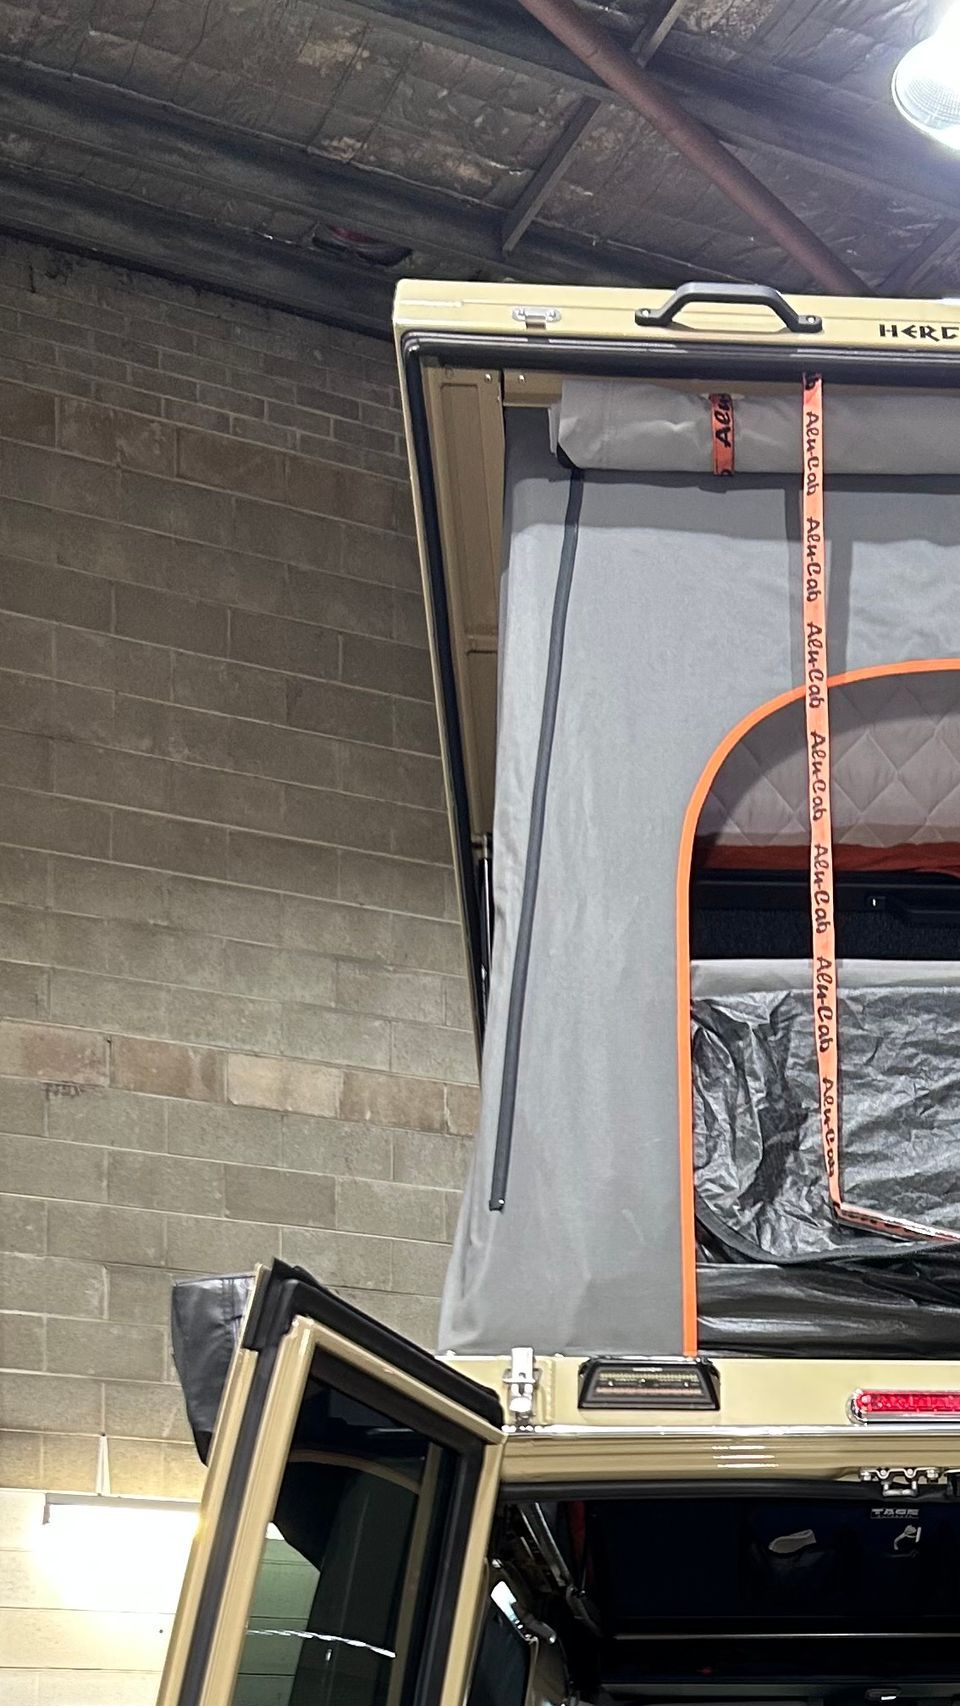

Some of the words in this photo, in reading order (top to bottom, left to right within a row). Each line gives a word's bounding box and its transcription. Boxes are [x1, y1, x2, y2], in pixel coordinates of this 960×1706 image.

[806, 411, 819, 496] Alu-Cab
[806, 516, 821, 602] Alu-Cab
[806, 621, 825, 709] Alu-Cab
[810, 730, 827, 821] Alu-Cab
[814, 843, 831, 934] Alu-Cab
[816, 956, 833, 1053] Alu-Cab
